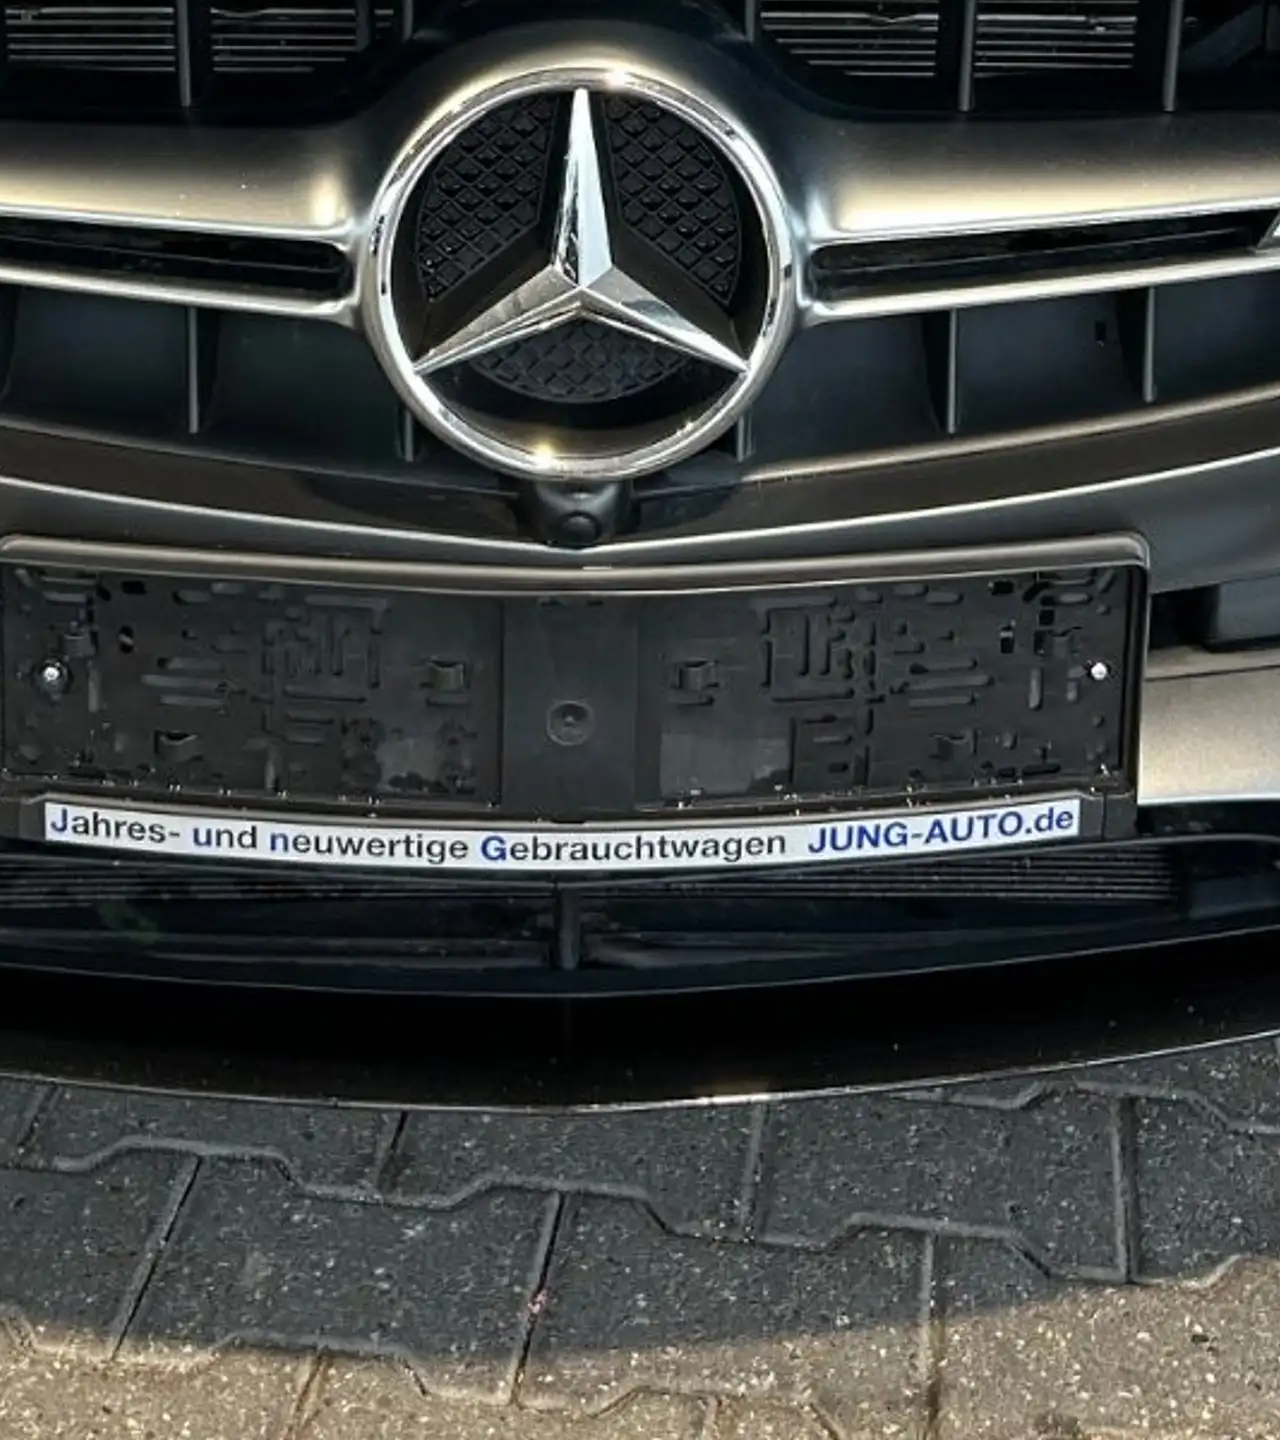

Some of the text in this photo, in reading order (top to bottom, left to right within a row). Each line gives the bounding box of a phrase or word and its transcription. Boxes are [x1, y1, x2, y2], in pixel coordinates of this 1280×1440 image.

[50, 806, 1074, 864] Jahres- und neuwertige Gebrauchtwagen JUNG-AUTO.de
